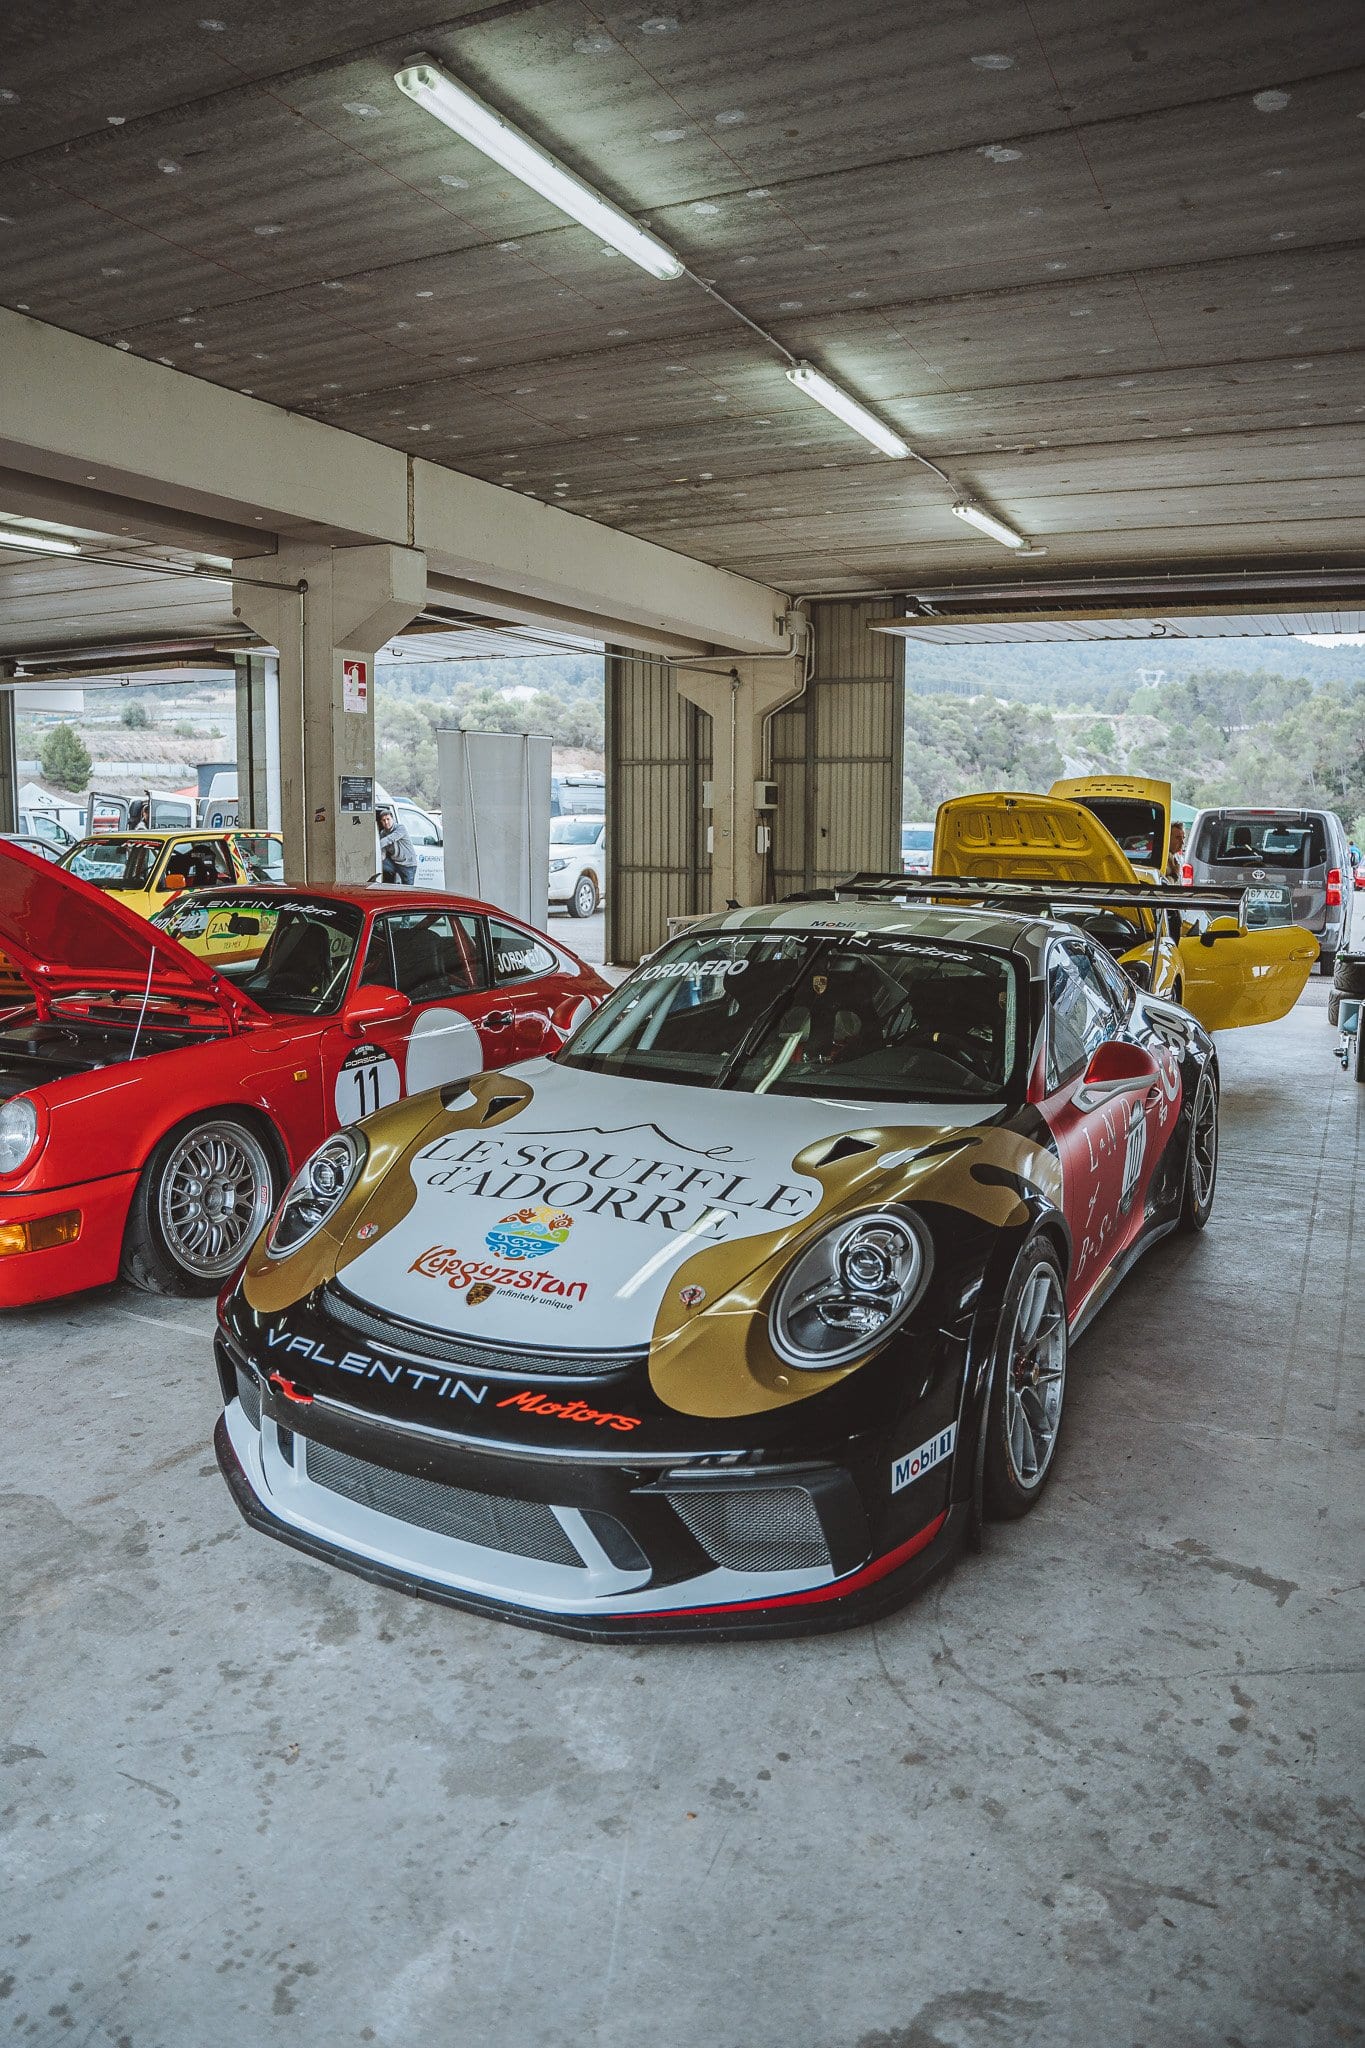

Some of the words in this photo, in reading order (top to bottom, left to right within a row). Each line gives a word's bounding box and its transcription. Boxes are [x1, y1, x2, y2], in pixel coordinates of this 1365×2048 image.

[172, 900, 274, 911] VALENTIN
[275, 902, 337, 917] Motors
[1264, 890, 1280, 899] KZC
[810, 920, 856, 928] Mobil
[696, 934, 872, 948] VALENTIN
[878, 941, 974, 962] Motors
[699, 959, 750, 976] EDO
[345, 1053, 387, 1068] PORSCHE
[354, 1066, 380, 1117] 11
[420, 1137, 504, 1164] LE
[501, 1144, 815, 1217] SOUFFLE
[426, 1166, 739, 1240] d'ADORRE
[408, 1244, 588, 1302] Kyrgyzstan
[496, 1287, 538, 1304] infinitely
[539, 1297, 574, 1311] unique
[267, 1328, 489, 1404] VALENTIN
[496, 1390, 642, 1431] Motors
[896, 1440, 937, 1487] Mobil
